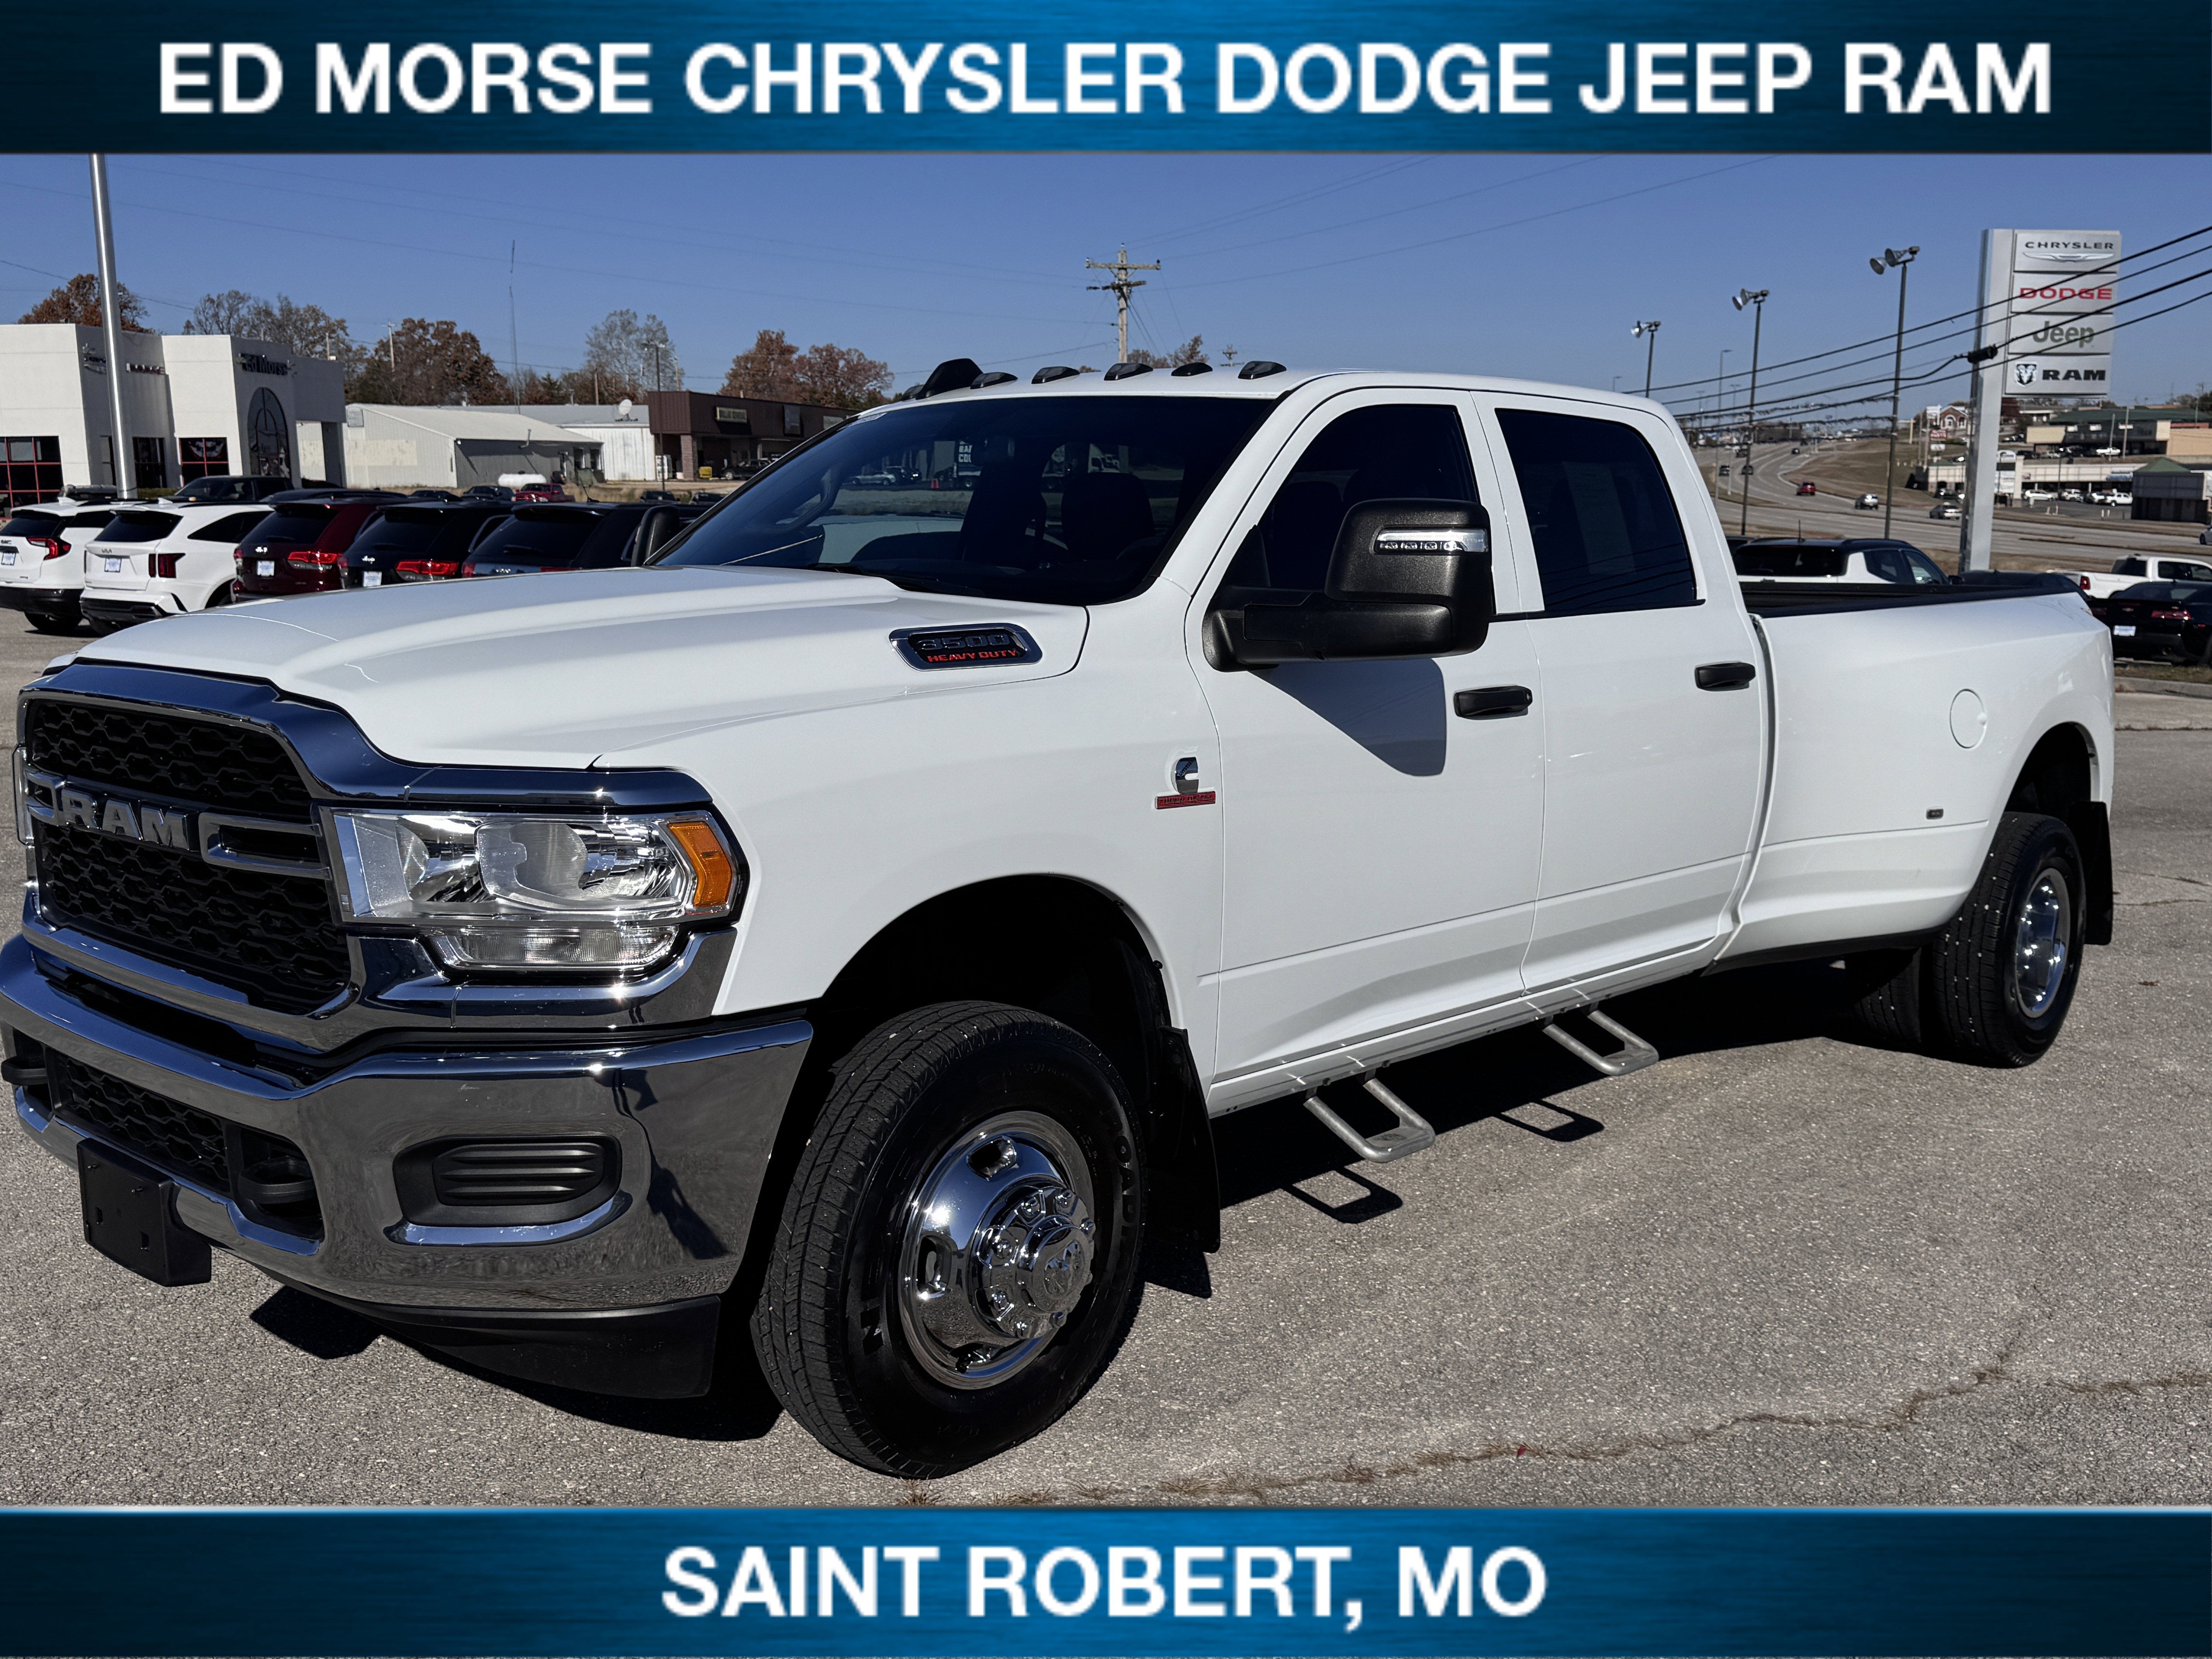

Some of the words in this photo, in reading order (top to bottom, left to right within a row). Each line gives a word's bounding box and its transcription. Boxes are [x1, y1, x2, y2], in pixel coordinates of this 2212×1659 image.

[2025, 241, 2114, 249] CHRYSLER
[2020, 287, 2112, 300] DODGE
[2032, 321, 2094, 348] Jeep
[2042, 369, 2106, 381] RAM
[916, 634, 1010, 651] 3500
[927, 652, 976, 663] HEAVY
[979, 649, 1019, 659] DUTY
[61, 787, 191, 851] RAM
